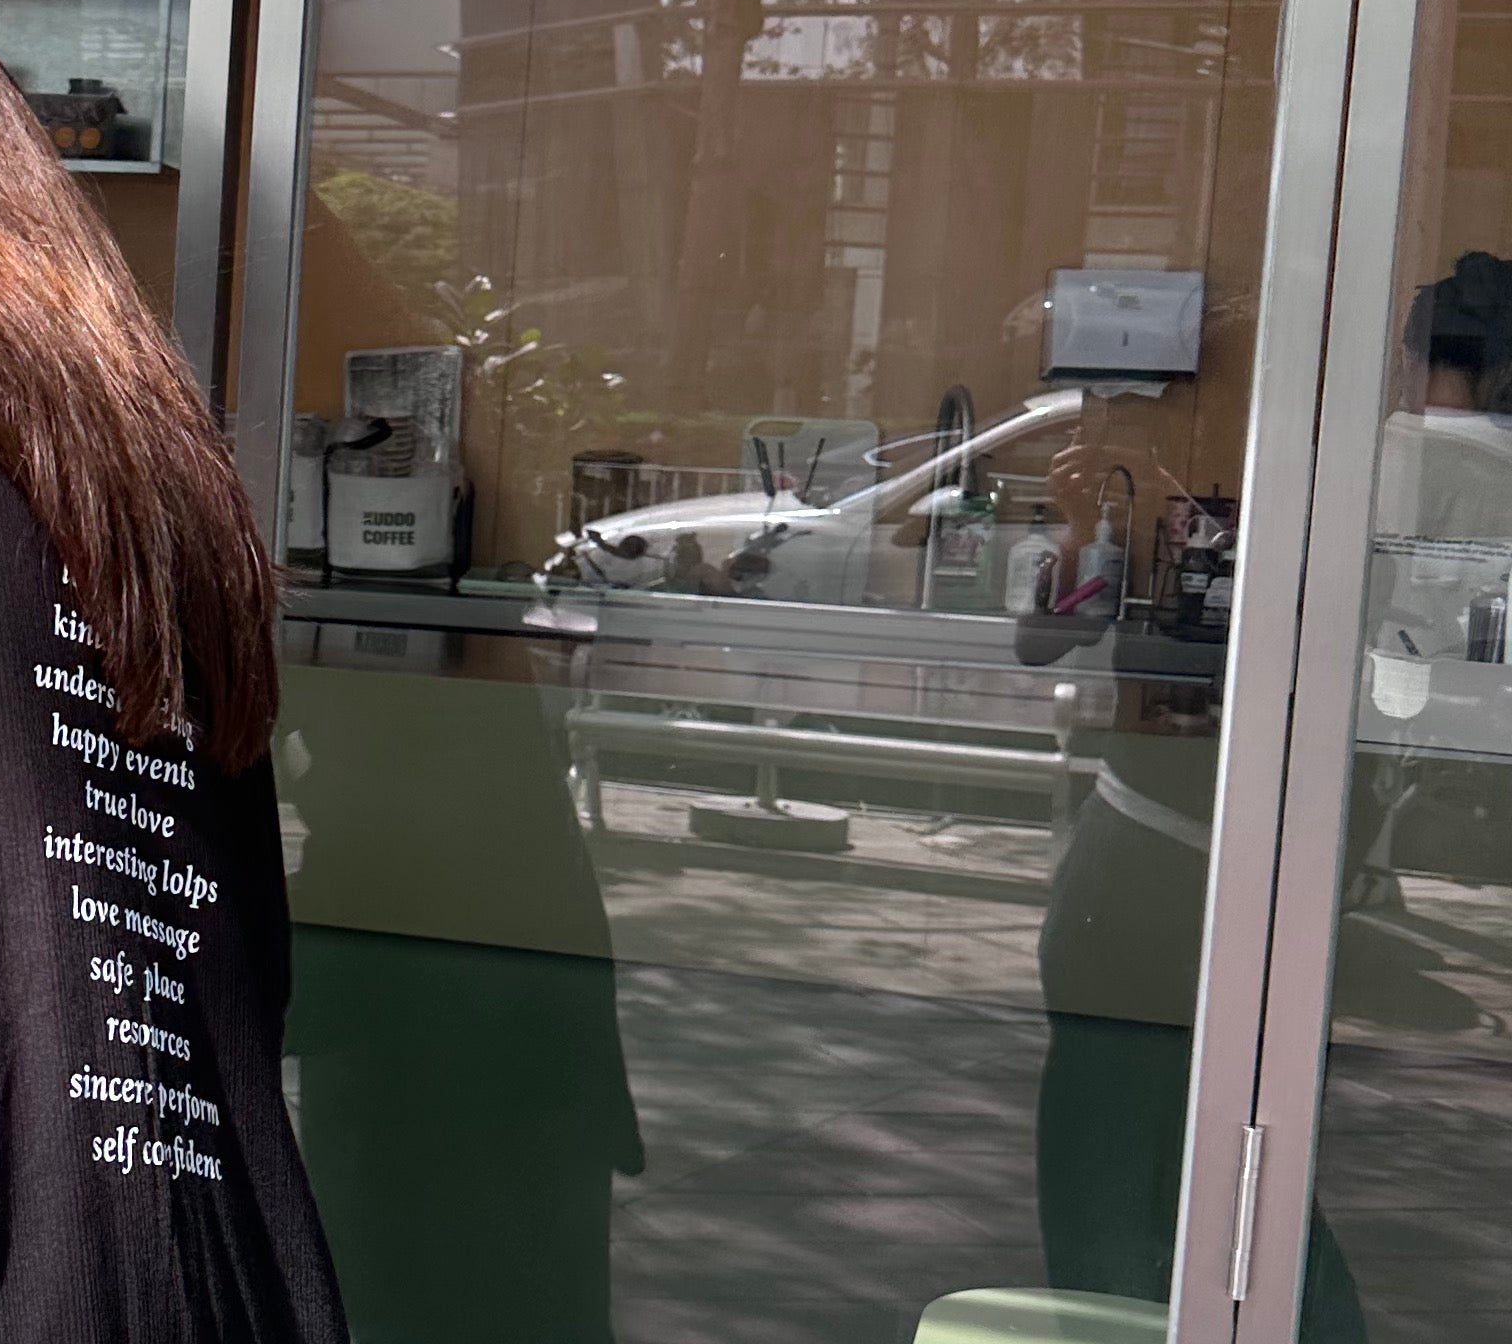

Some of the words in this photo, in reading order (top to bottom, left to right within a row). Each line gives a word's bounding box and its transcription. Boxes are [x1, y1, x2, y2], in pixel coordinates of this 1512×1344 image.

[363, 511, 416, 526] KUDDO
[363, 529, 415, 545] COFFEE
[52, 711, 120, 772] happy
[125, 749, 196, 791] events
[85, 779, 128, 820] true
[130, 793, 176, 838] love
[43, 825, 158, 897] interesting
[162, 859, 219, 910] lolps
[71, 884, 121, 927] love
[124, 907, 201, 961] message
[89, 950, 134, 995] safe
[143, 961, 185, 1005] place
[106, 1016, 191, 1062] resources
[69, 1064, 154, 1105] sincere
[157, 1082, 220, 1127] perform
[91, 1125, 140, 1175] self
[142, 1135, 223, 1181] confidenc
